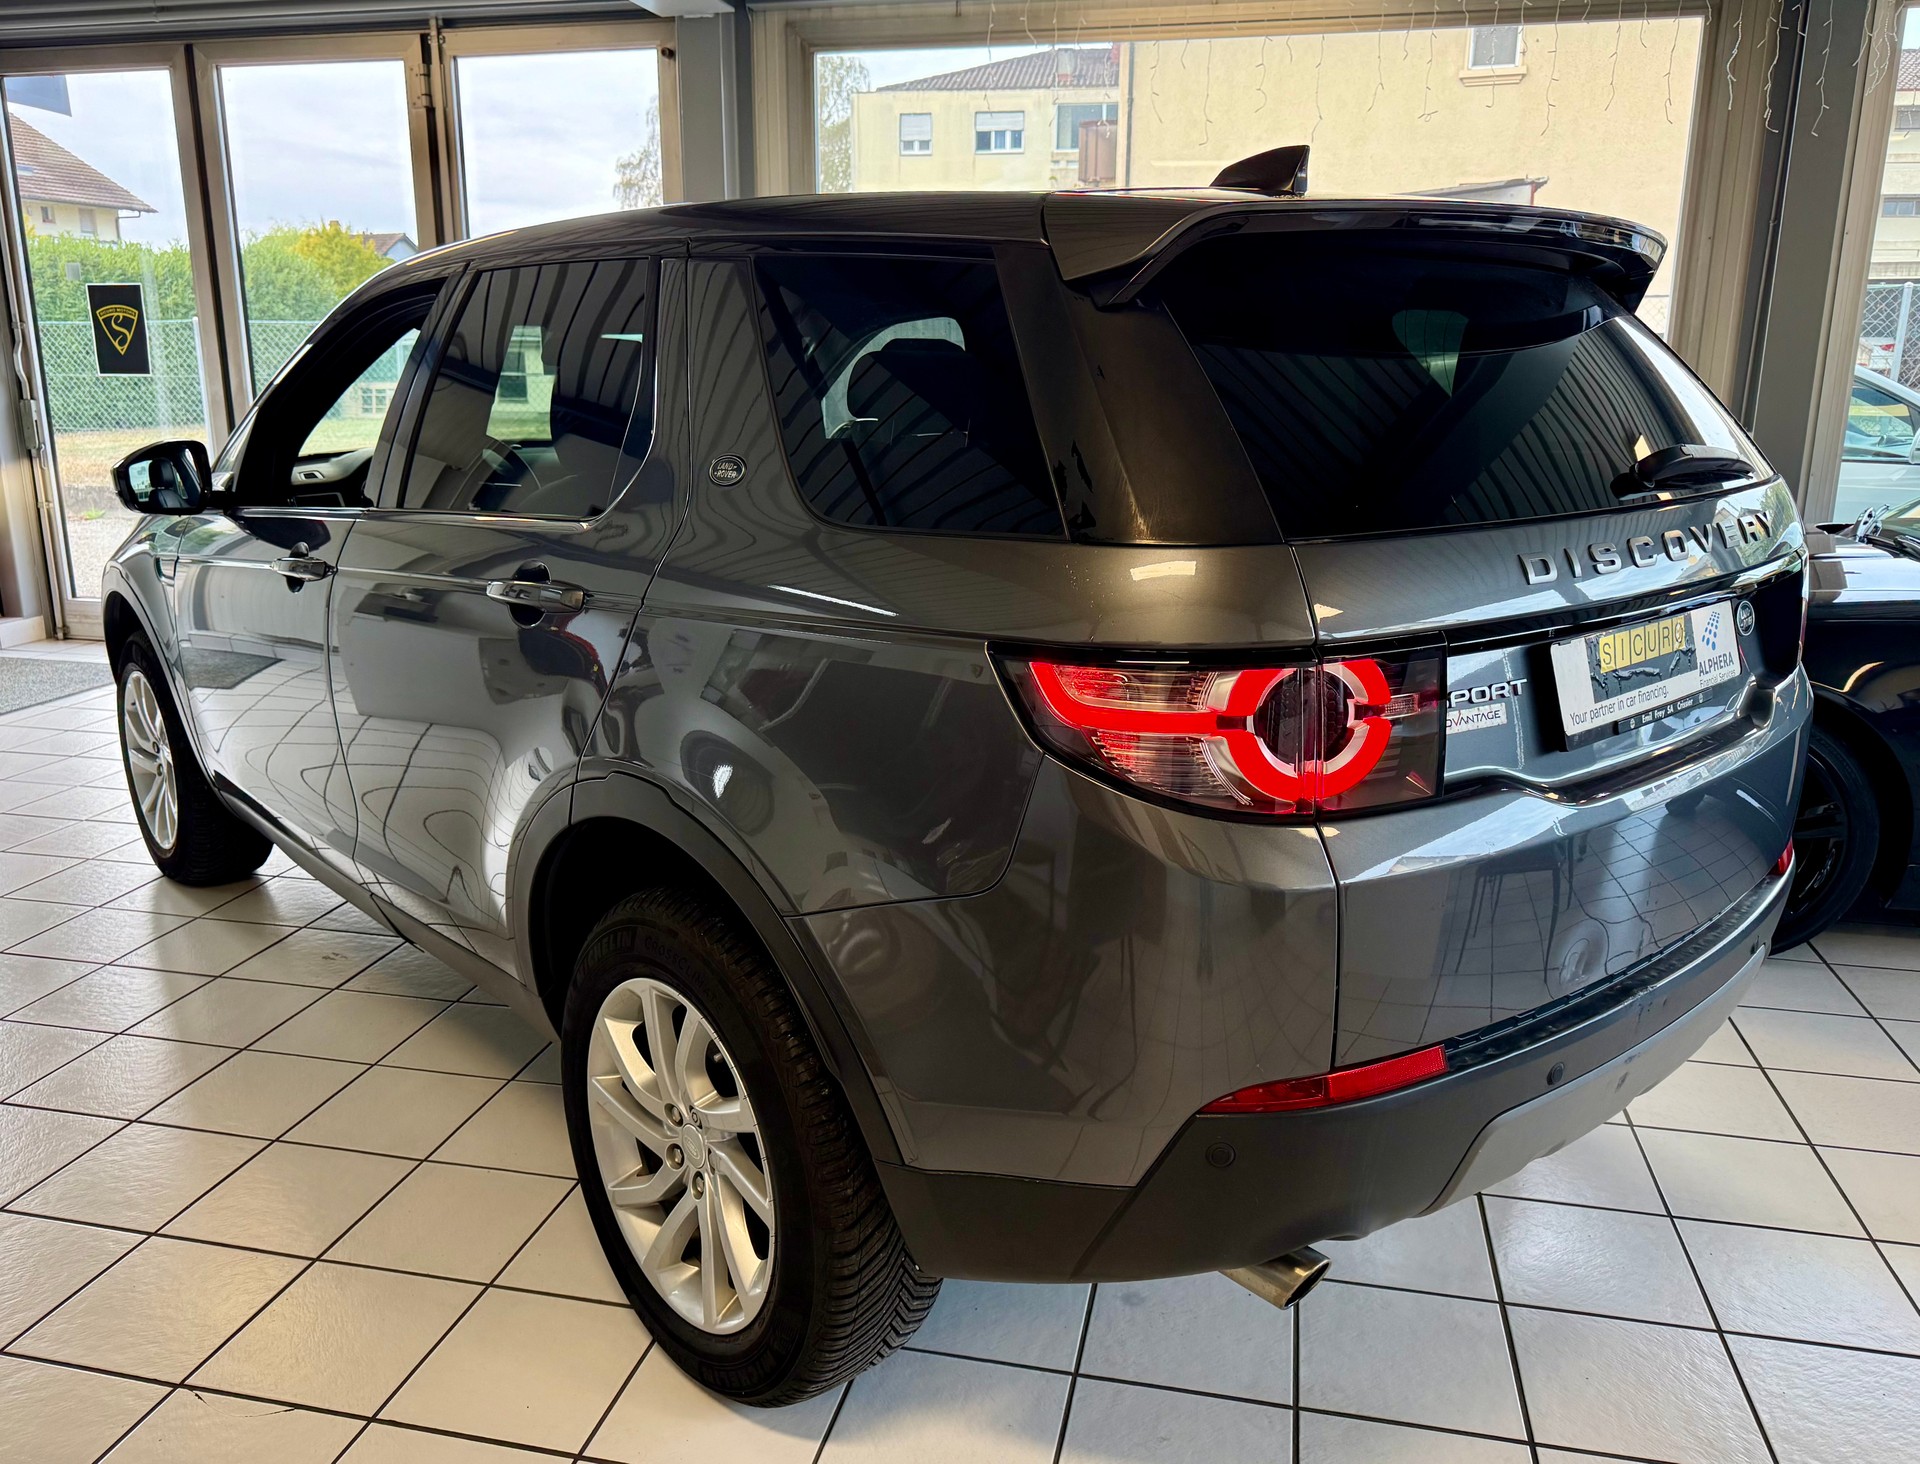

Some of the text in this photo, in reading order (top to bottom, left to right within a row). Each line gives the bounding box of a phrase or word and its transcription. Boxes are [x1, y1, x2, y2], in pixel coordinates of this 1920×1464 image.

[1518, 510, 1774, 585] DISCOVERY
[1602, 622, 1684, 665] SICURO
[1699, 652, 1734, 676] ALPHERA
[1700, 669, 1736, 688] Financial Services
[1447, 679, 1527, 708] PORT
[1570, 685, 1669, 726] Your partner in car financing.
[1446, 710, 1501, 728] DVANTAGE
[1667, 705, 1674, 714] SA
